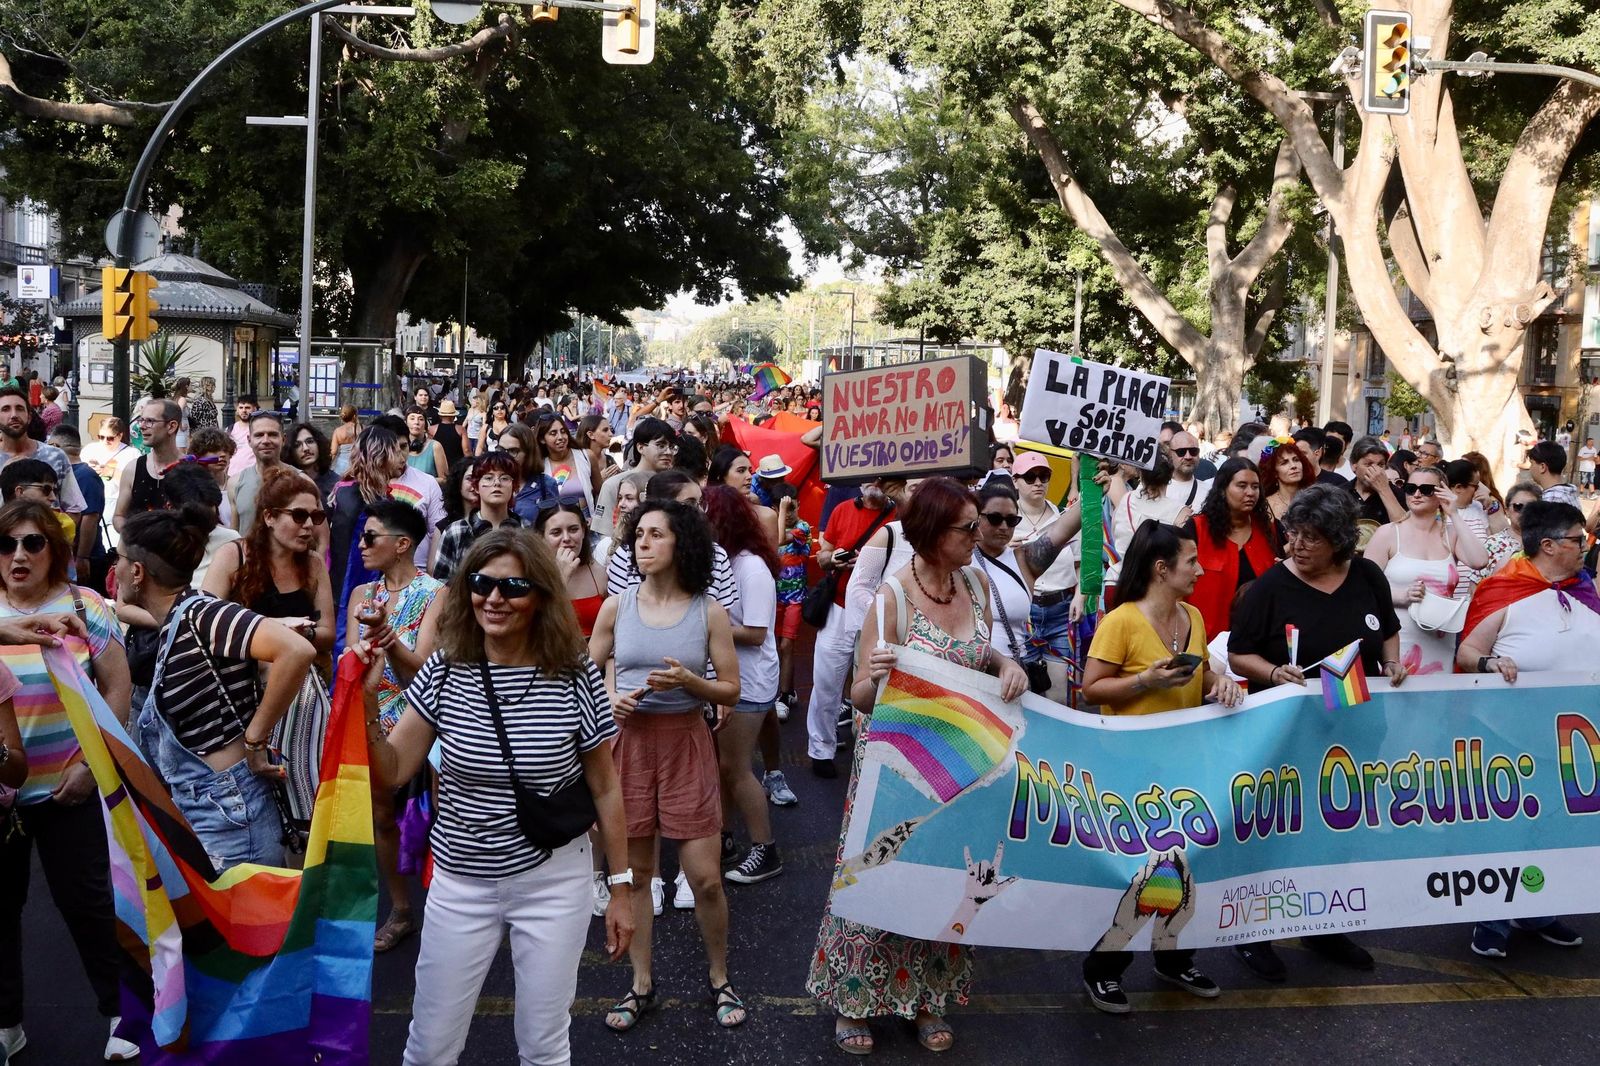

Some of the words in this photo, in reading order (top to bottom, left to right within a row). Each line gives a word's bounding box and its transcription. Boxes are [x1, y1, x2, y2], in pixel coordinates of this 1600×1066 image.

[833, 366, 956, 413] NUESTRO
[1044, 359, 1090, 399] LA
[923, 400, 967, 432] MATA
[825, 439, 898, 474] VUESTRO
[1045, 419, 1157, 464] VOSOTROS
[1008, 749, 1220, 856] Málaga
[1231, 763, 1303, 843] con
[1319, 737, 1540, 831] Orgullo:
[1218, 887, 1367, 929] DIVERSIDAD
[1221, 876, 1297, 904] ANDALUCÍA
[1215, 928, 1275, 943] FEDERACIÓN
[1280, 922, 1336, 934] ANDALUZA
[1341, 918, 1368, 928] LGBT
